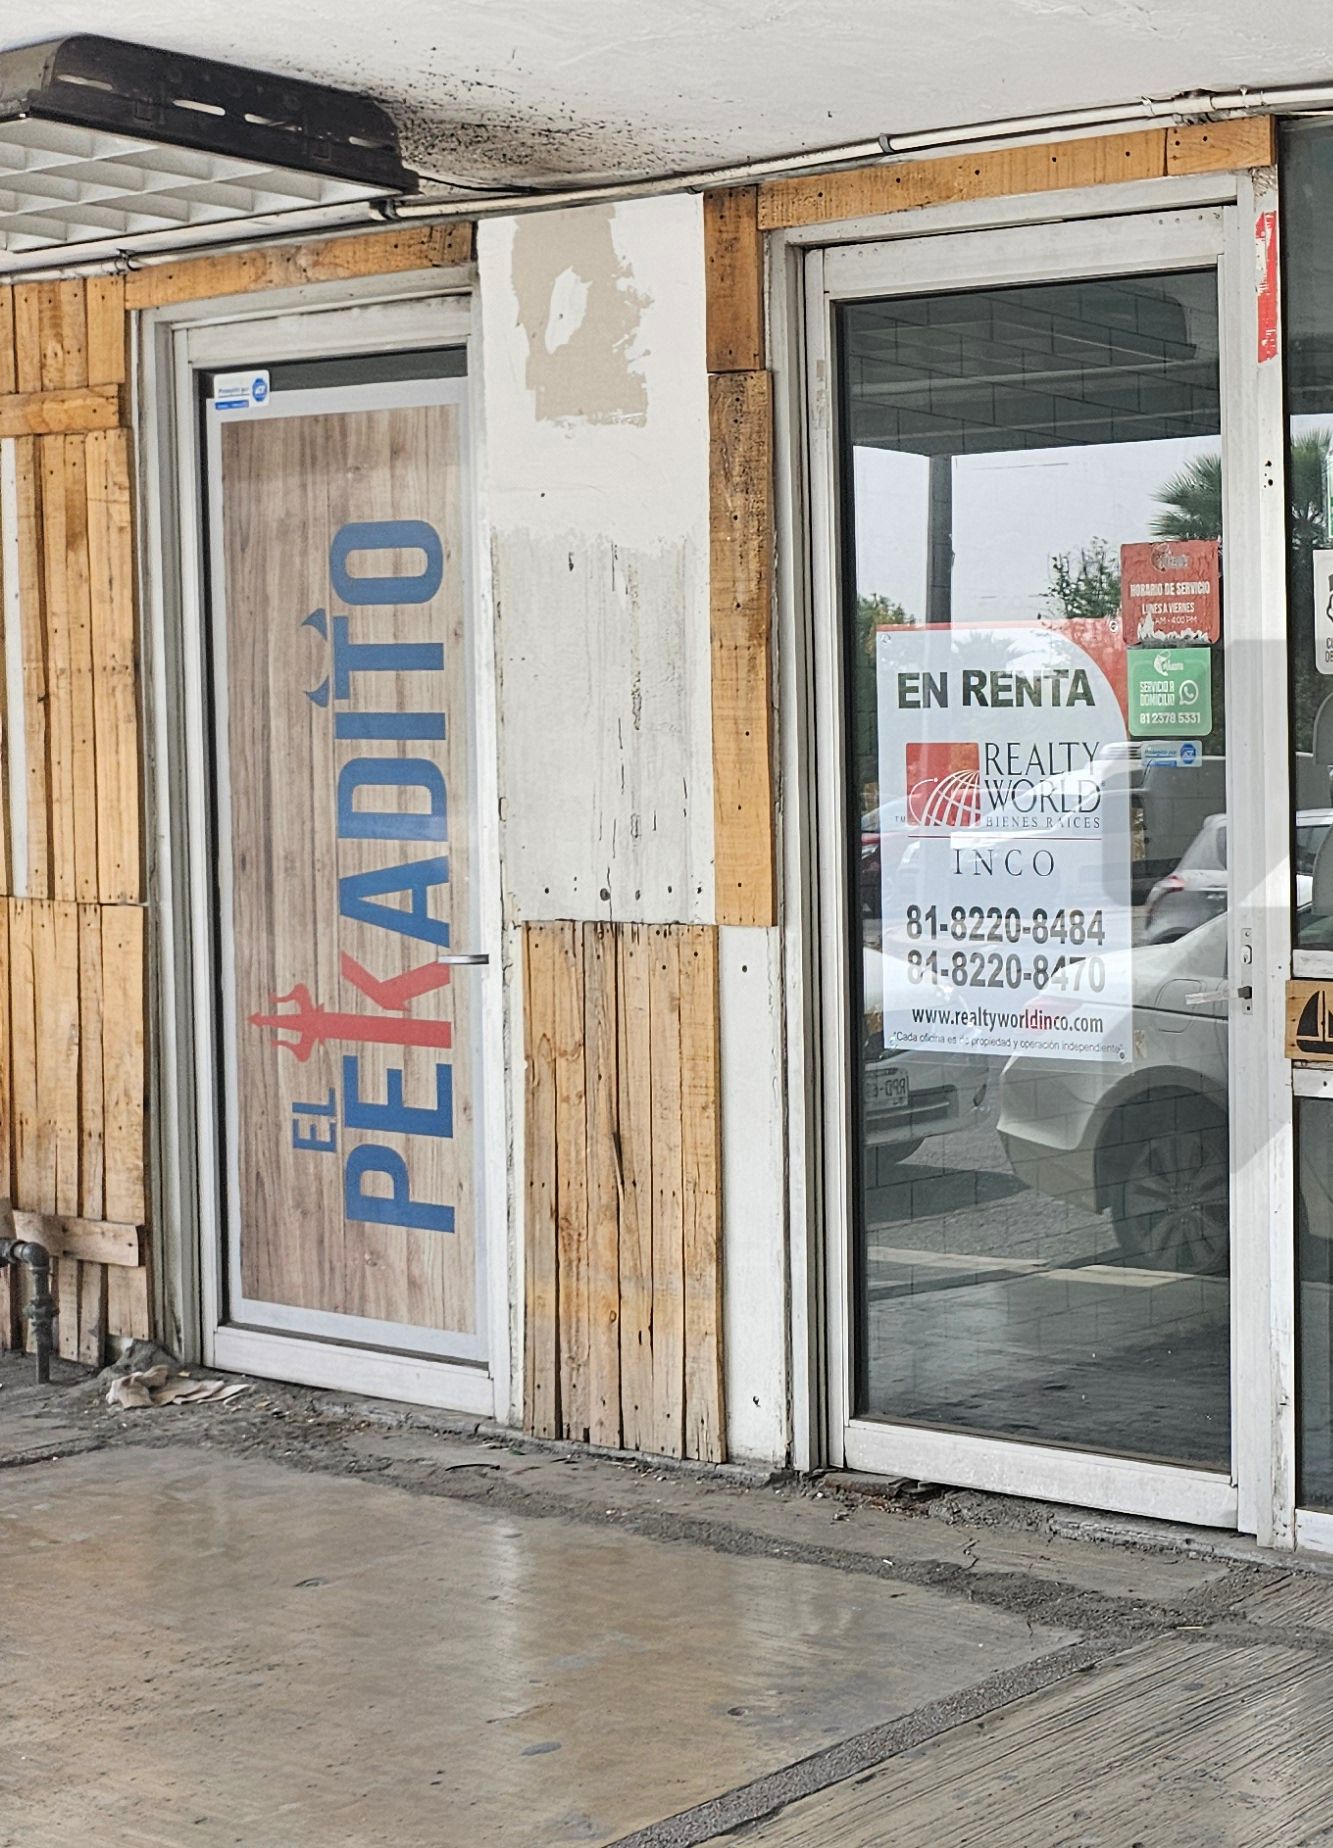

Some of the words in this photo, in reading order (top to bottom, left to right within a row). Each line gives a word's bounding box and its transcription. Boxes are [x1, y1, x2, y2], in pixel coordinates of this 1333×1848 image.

[1130, 583, 1163, 597] HORARIO
[1165, 582, 1175, 596] DE
[1176, 581, 1211, 595] SERVICIO
[1142, 603, 1163, 615] LUNES
[1163, 603, 1169, 613] A
[1169, 602, 1195, 613] VIERNES
[1186, 615, 1198, 624] PM
[898, 671, 948, 709] EN
[962, 668, 1096, 708] RENTA
[1139, 680, 1168, 693] SERVICIO
[1139, 693, 1175, 706] DOMICILIO
[1139, 712, 1150, 723] 81
[1152, 712, 1176, 723] 2378
[1178, 712, 1201, 723] 5331
[984, 741, 1101, 776] REALTY
[984, 779, 1102, 814] WORLD
[986, 816, 1039, 828] BIENES
[328, 519, 456, 1234] PEKADITO
[953, 848, 1056, 877] INCO
[905, 904, 1106, 946] 81-8220-8484
[906, 949, 1106, 993] 81-8220-8470
[911, 1005, 1104, 1034] www.realtyworldinco.com
[920, 1033, 945, 1044] oficina
[971, 1037, 1011, 1049] propiedad
[1019, 1039, 1060, 1051] operación
[291, 1088, 337, 1153] EL
